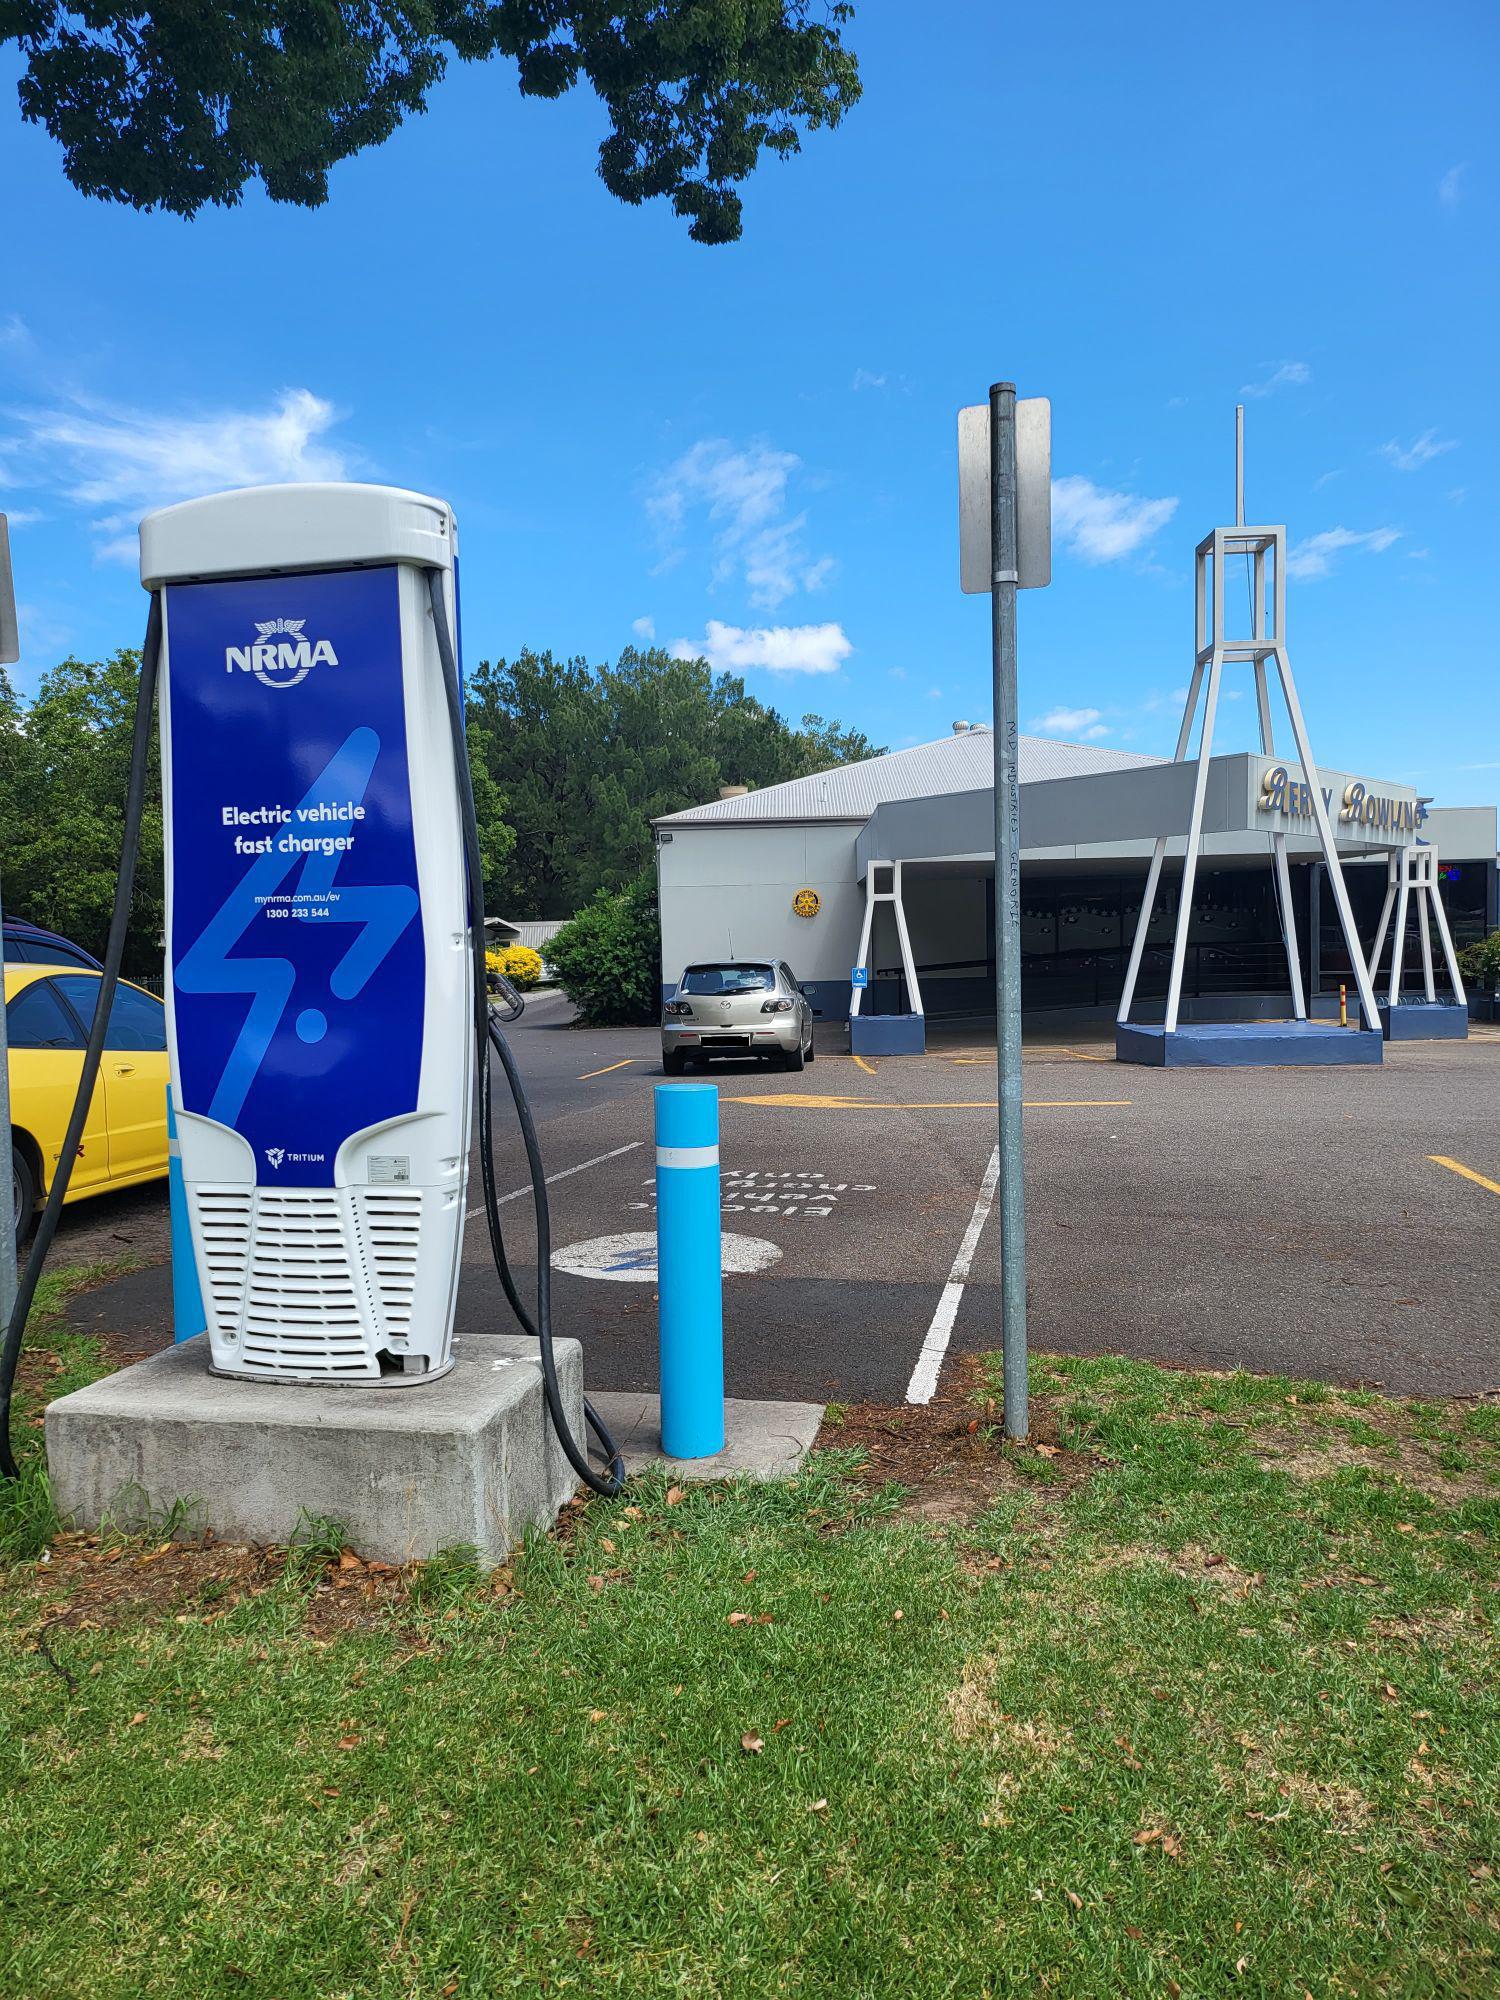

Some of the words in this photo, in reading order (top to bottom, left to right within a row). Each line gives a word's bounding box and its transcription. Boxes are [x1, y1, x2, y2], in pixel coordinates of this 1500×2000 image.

[225, 640, 339, 673] NRMA
[1008, 762, 1019, 833] INDUSTRIES
[1258, 767, 1333, 817] BERY
[1340, 783, 1423, 830] BOWLING
[222, 805, 292, 826] Electric
[297, 802, 366, 823] vehicle
[234, 834, 273, 855] fast
[278, 833, 355, 856] charger
[254, 891, 341, 906] mynrma.com.au/ev
[266, 909, 289, 919] 1300
[291, 908, 309, 918] 233
[311, 907, 330, 918] 544
[287, 1153, 325, 1162] TRITIUM
